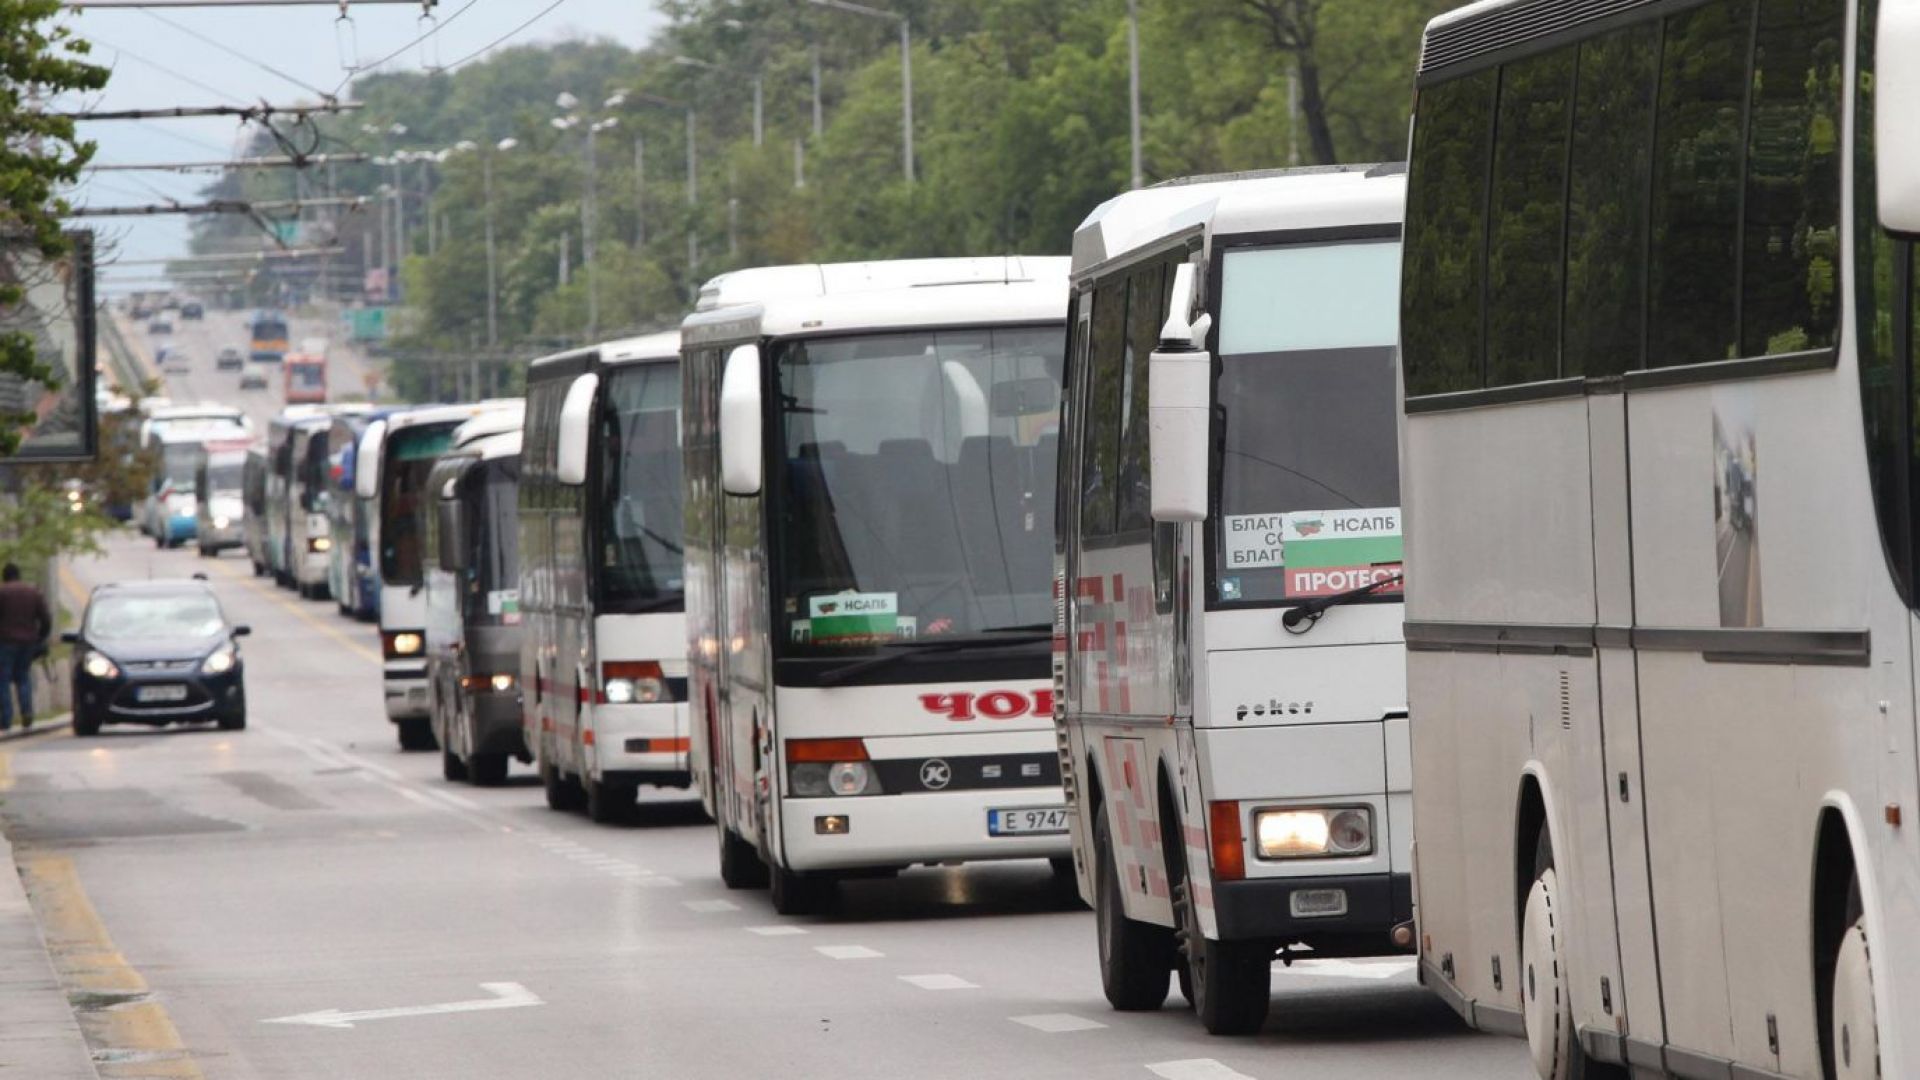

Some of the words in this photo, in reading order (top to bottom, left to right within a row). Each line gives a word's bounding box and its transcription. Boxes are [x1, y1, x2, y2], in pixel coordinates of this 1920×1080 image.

[1333, 516, 1396, 532] НСАПБ
[1233, 549, 1284, 564] БЛАГ
[1026, 811, 1067, 828] 9747
